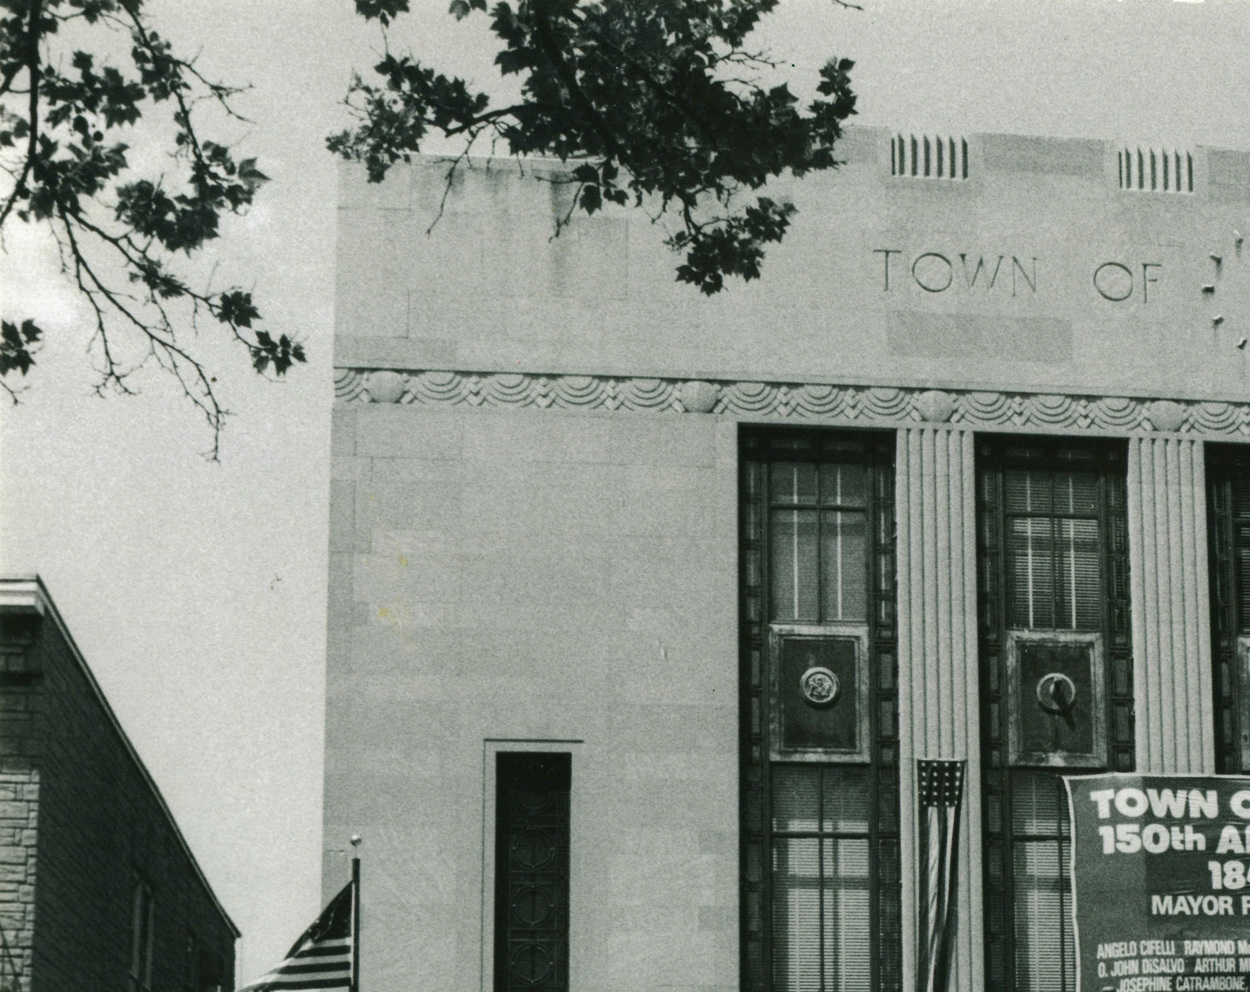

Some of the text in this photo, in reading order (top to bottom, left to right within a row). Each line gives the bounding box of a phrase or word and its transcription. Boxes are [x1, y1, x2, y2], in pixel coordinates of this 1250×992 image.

[873, 248, 1038, 297] TOWN
[1093, 261, 1162, 303] OF
[1090, 787, 1219, 819] TOWN
[1099, 823, 1206, 854] 150th
[1152, 895, 1234, 915] MAYOR
[1097, 941, 1137, 960] ANGELO
[1139, 940, 1175, 956] CIFELLI
[1184, 940, 1235, 956] RAYMOND
[1111, 959, 1139, 977] JOHN
[1194, 957, 1236, 973] ARTHUR
[1176, 976, 1248, 992] CATRAMBONE,
